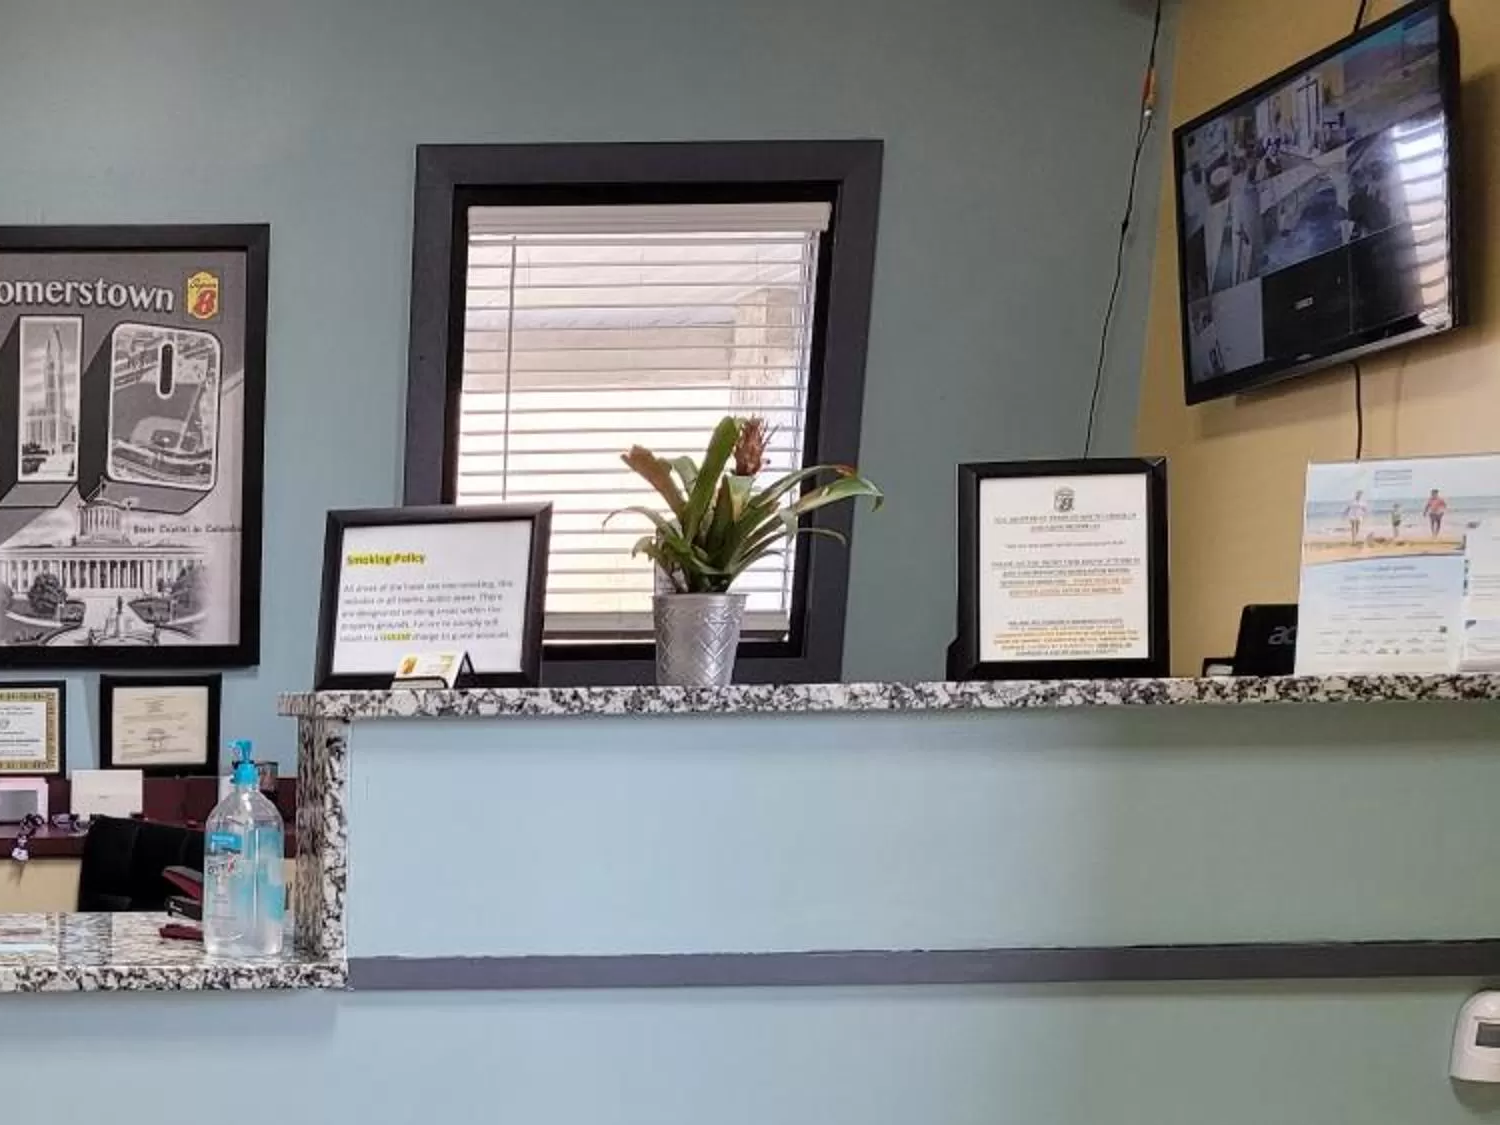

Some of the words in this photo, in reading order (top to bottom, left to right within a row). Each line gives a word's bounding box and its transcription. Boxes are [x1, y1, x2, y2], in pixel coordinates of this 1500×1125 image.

[347, 553, 391, 566] Smoking
[394, 550, 425, 564] Policy
[1268, 625, 1297, 645] ac
